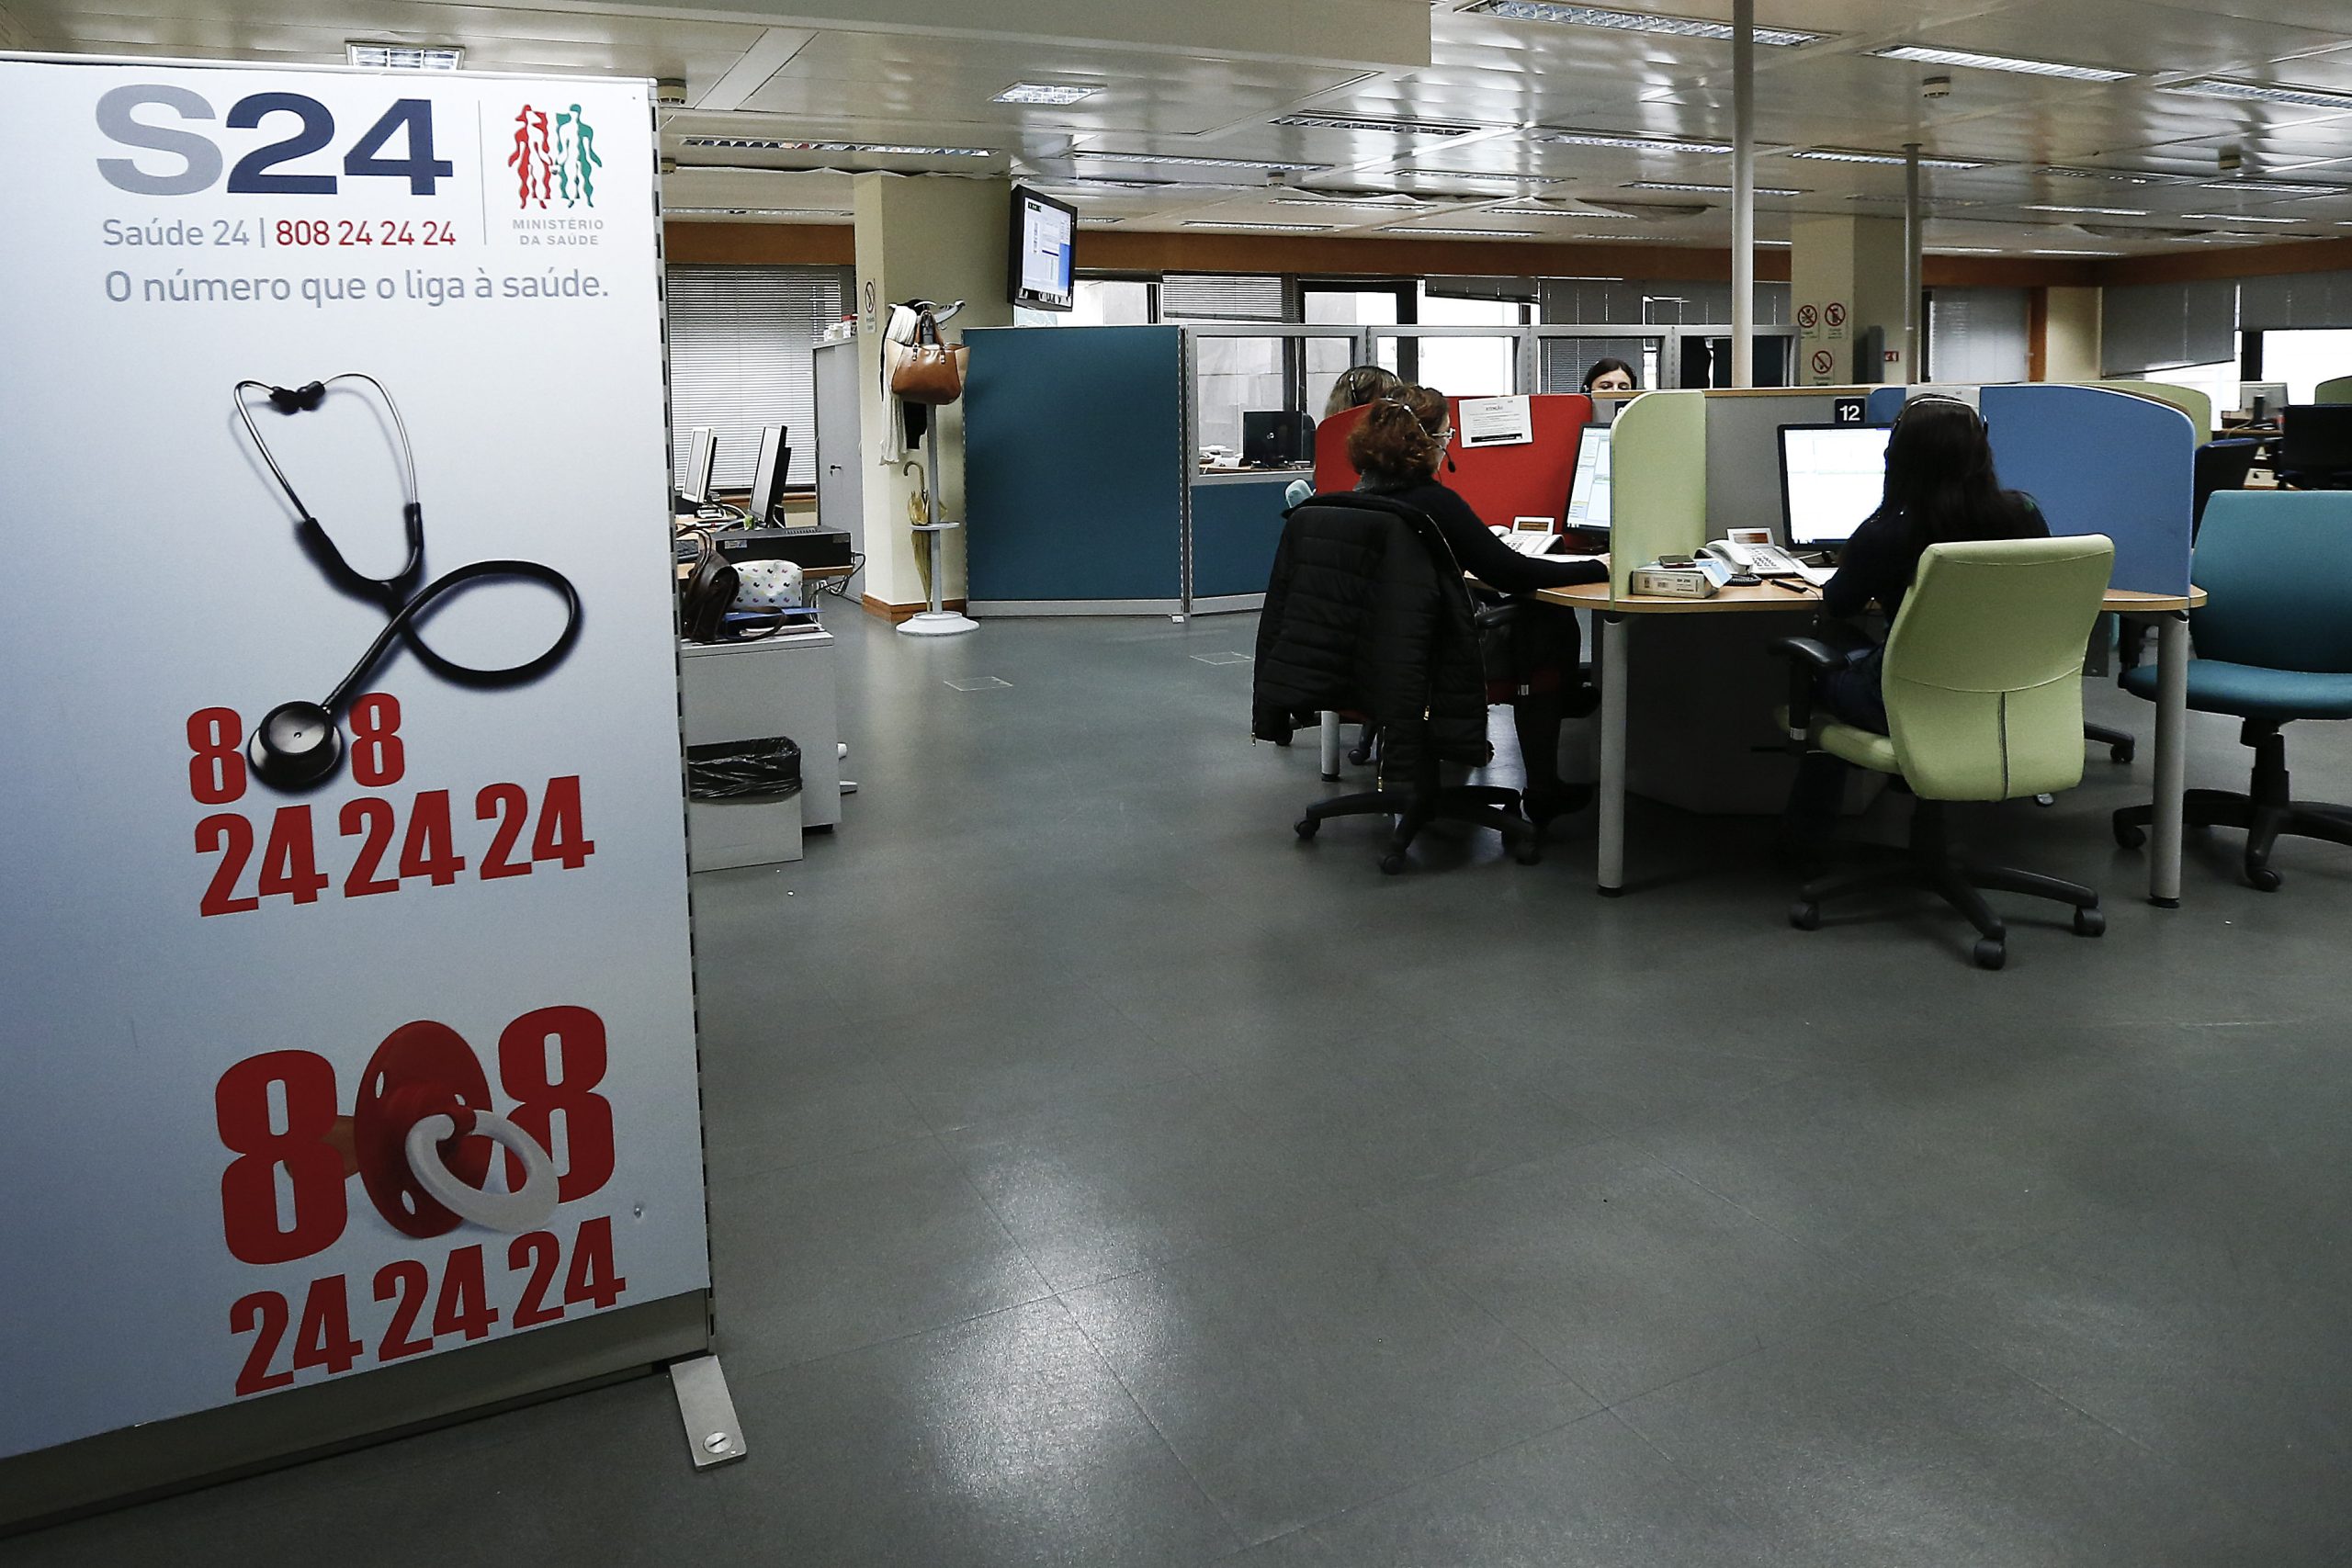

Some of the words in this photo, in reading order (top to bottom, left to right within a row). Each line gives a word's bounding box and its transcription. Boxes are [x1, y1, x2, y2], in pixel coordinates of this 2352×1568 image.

[96, 84, 453, 196] S24
[103, 218, 203, 245] Saúde
[213, 220, 250, 245] 24
[277, 220, 329, 245] 808
[339, 221, 371, 245] 24
[382, 221, 413, 245] 24
[424, 221, 456, 245] 24
[513, 217, 605, 230] MINISTÉRIO
[520, 235, 540, 245] DA
[547, 233, 599, 245] SAÚDE
[106, 271, 131, 302] O
[143, 268, 290, 301] número
[301, 278, 366, 308] que
[377, 278, 395, 299] o
[405, 269, 465, 307] liga
[475, 267, 492, 298] à
[503, 266, 608, 298] saúde.
[1839, 405, 1860, 421] 12
[195, 804, 329, 918] 24
[339, 789, 465, 897] 24
[475, 775, 594, 881] 24
[230, 1274, 363, 1397] 24
[373, 1244, 499, 1362] 24
[507, 1215, 626, 1329] 24
